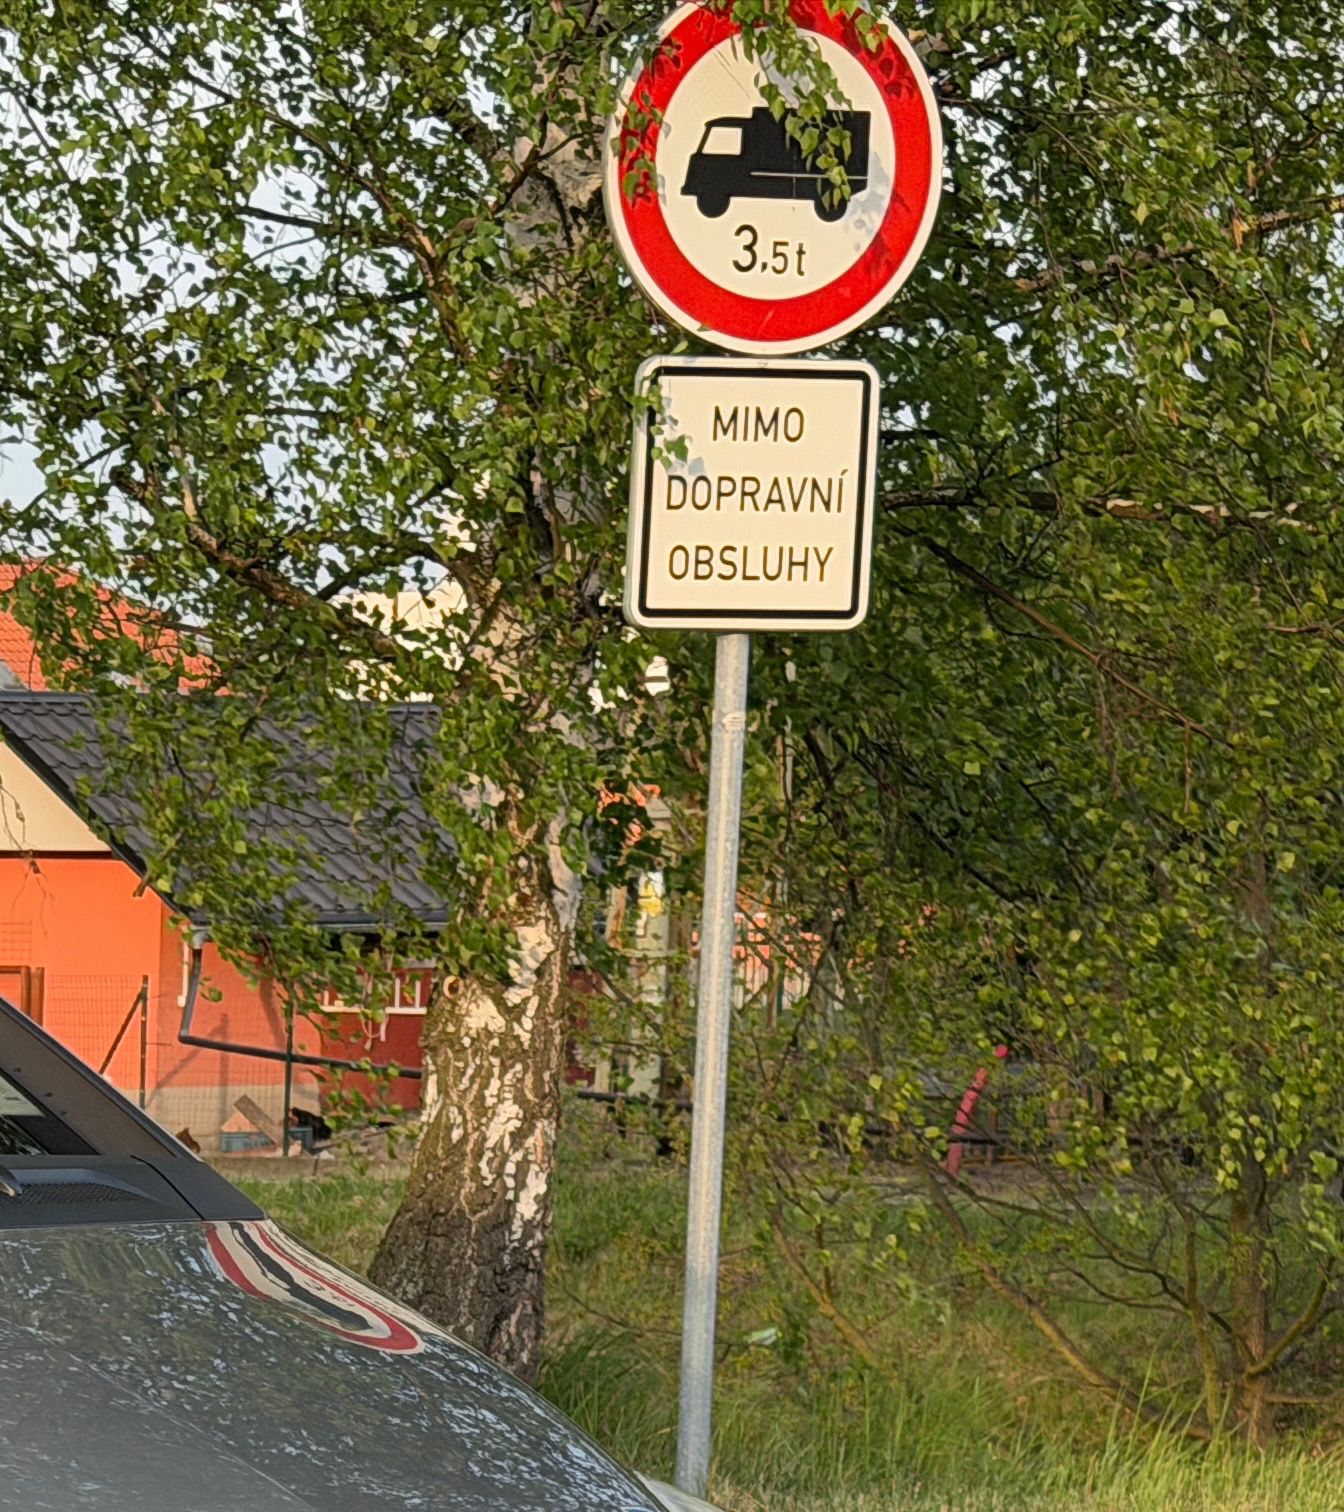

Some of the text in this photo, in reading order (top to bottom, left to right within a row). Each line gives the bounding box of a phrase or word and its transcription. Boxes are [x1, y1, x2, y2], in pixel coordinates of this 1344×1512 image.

[712, 405, 804, 443] MIMO
[665, 468, 849, 514] DOPRAVNÍ
[668, 545, 834, 583] OBSLUHY
